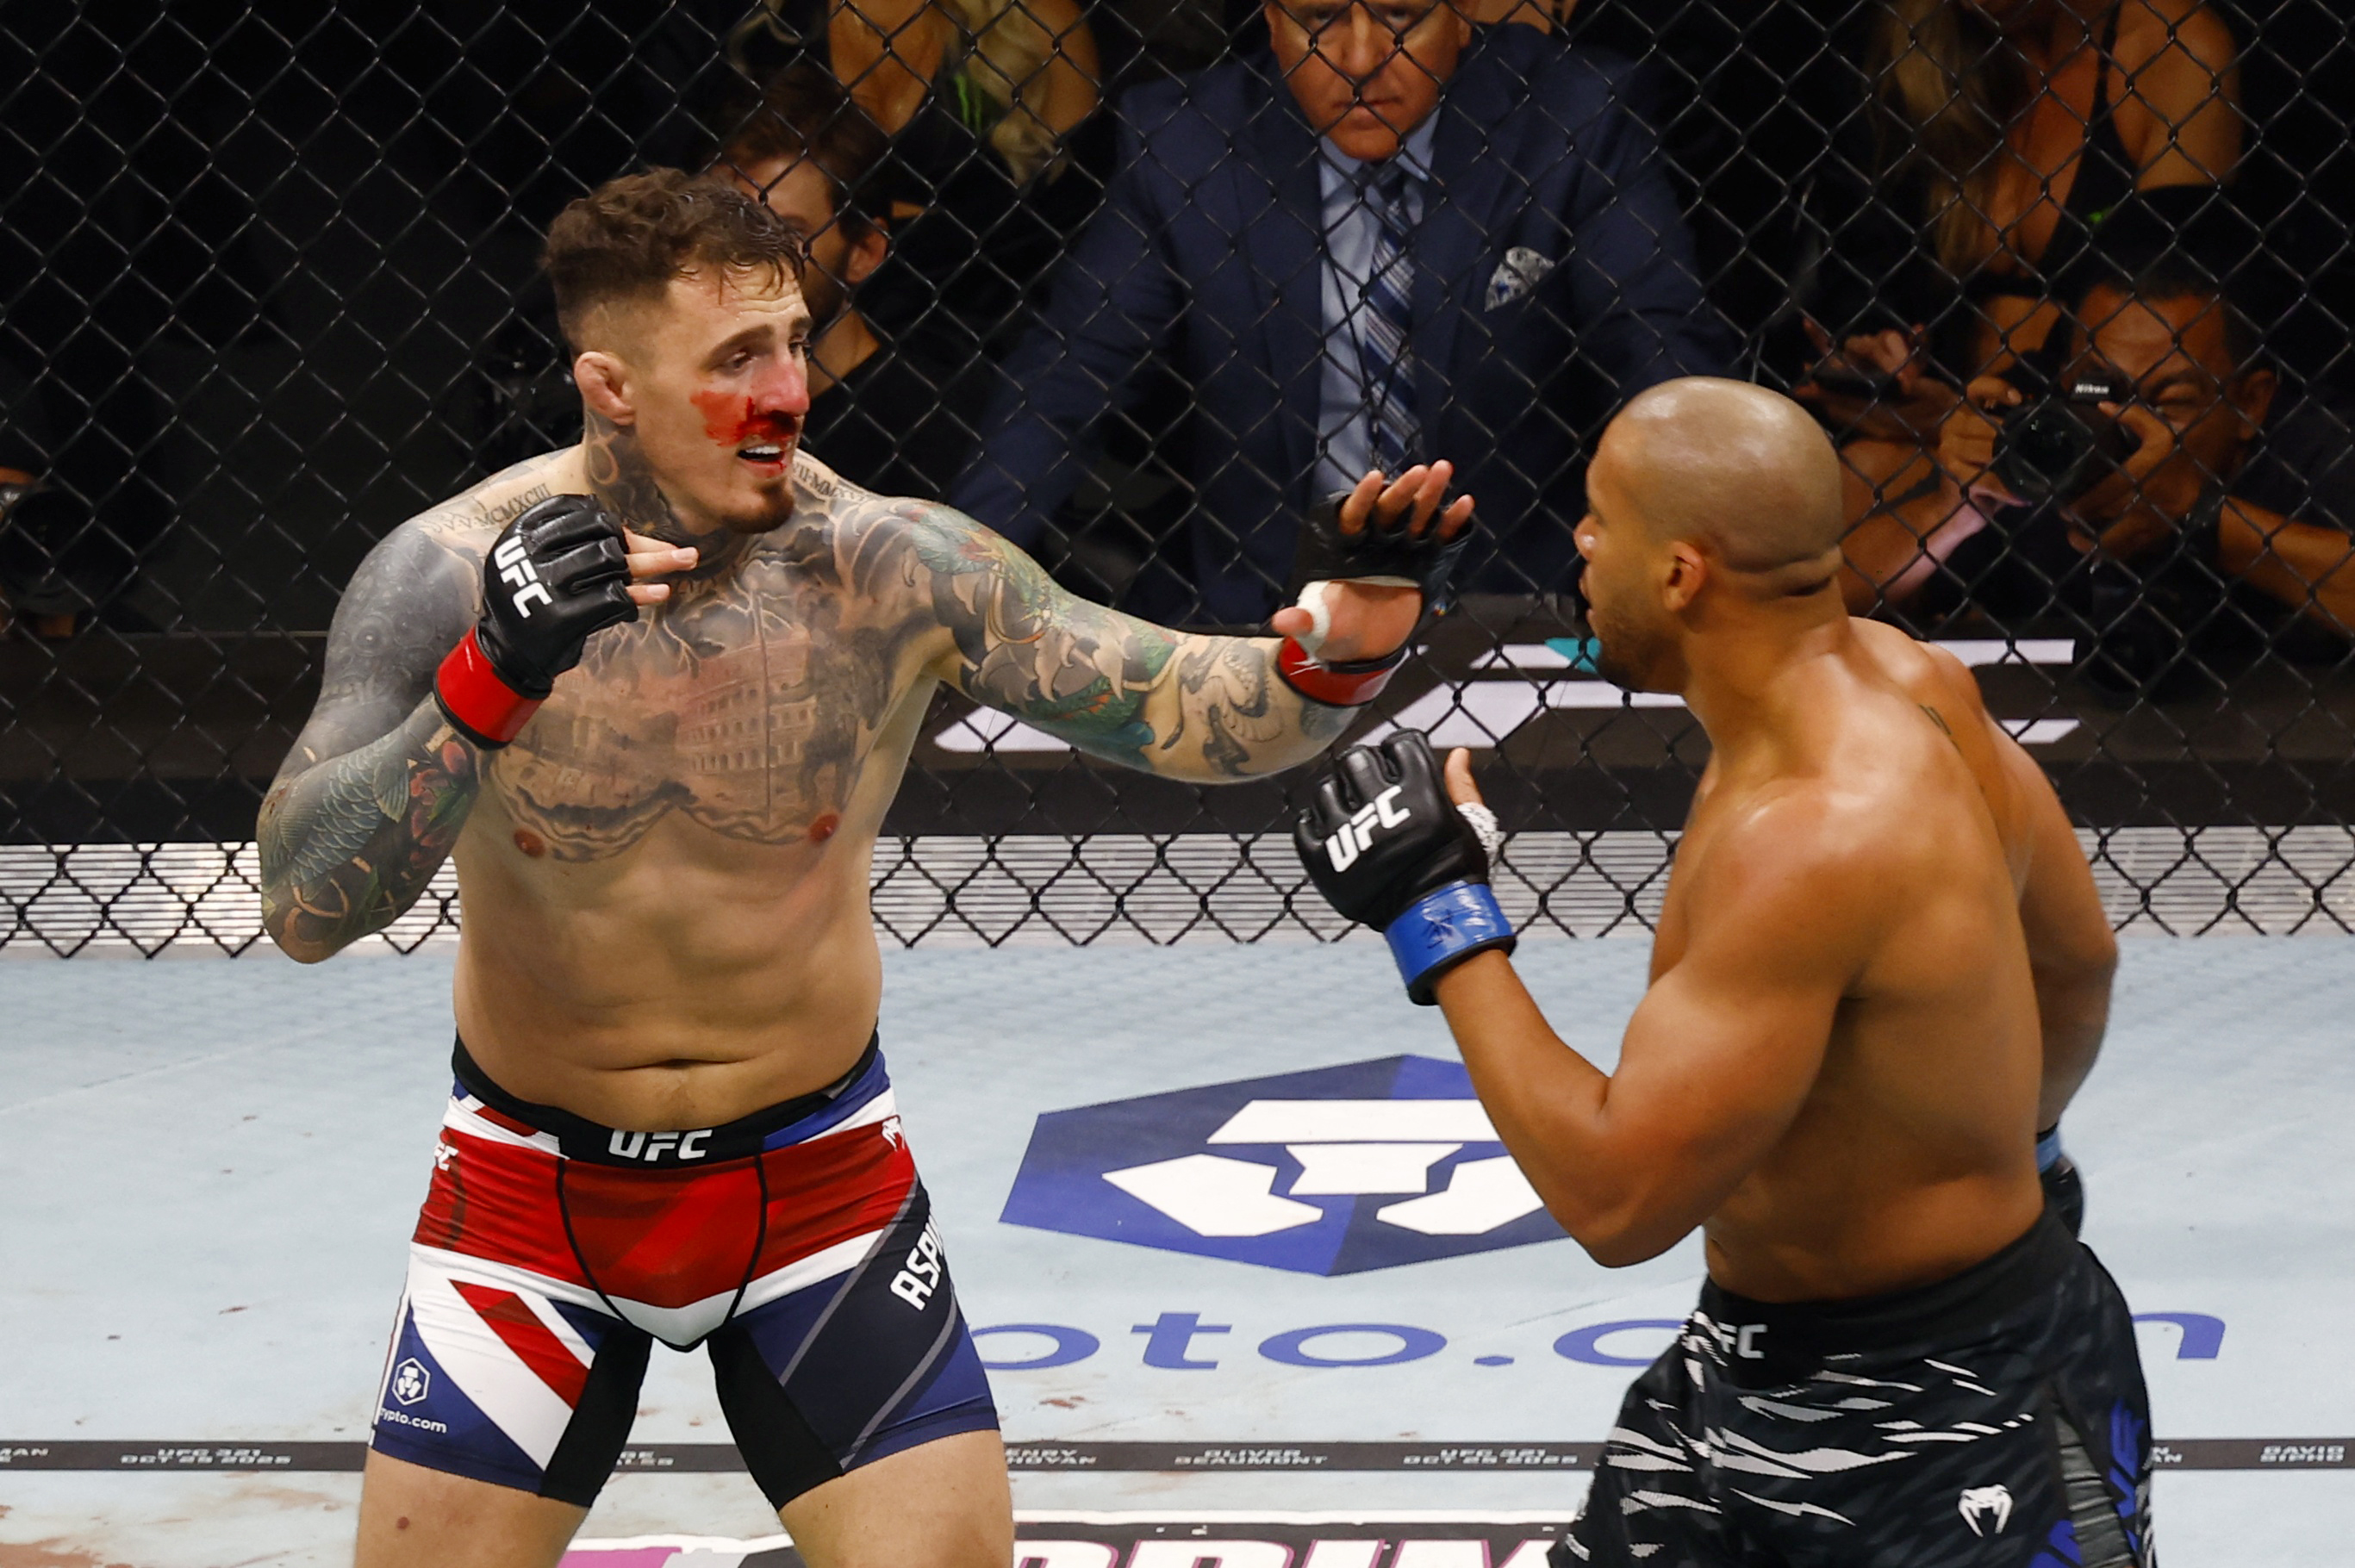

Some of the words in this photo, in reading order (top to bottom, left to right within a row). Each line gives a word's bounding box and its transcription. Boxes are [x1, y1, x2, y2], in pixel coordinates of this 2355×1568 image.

[2074, 383, 2110, 395] Nikon
[494, 534, 553, 619] UFC
[1324, 785, 1411, 873] UFC
[433, 1142, 459, 1172] FC
[607, 1129, 713, 1162] UFC
[1717, 1321, 1769, 1360] FC
[380, 1406, 448, 1434] rypto.com
